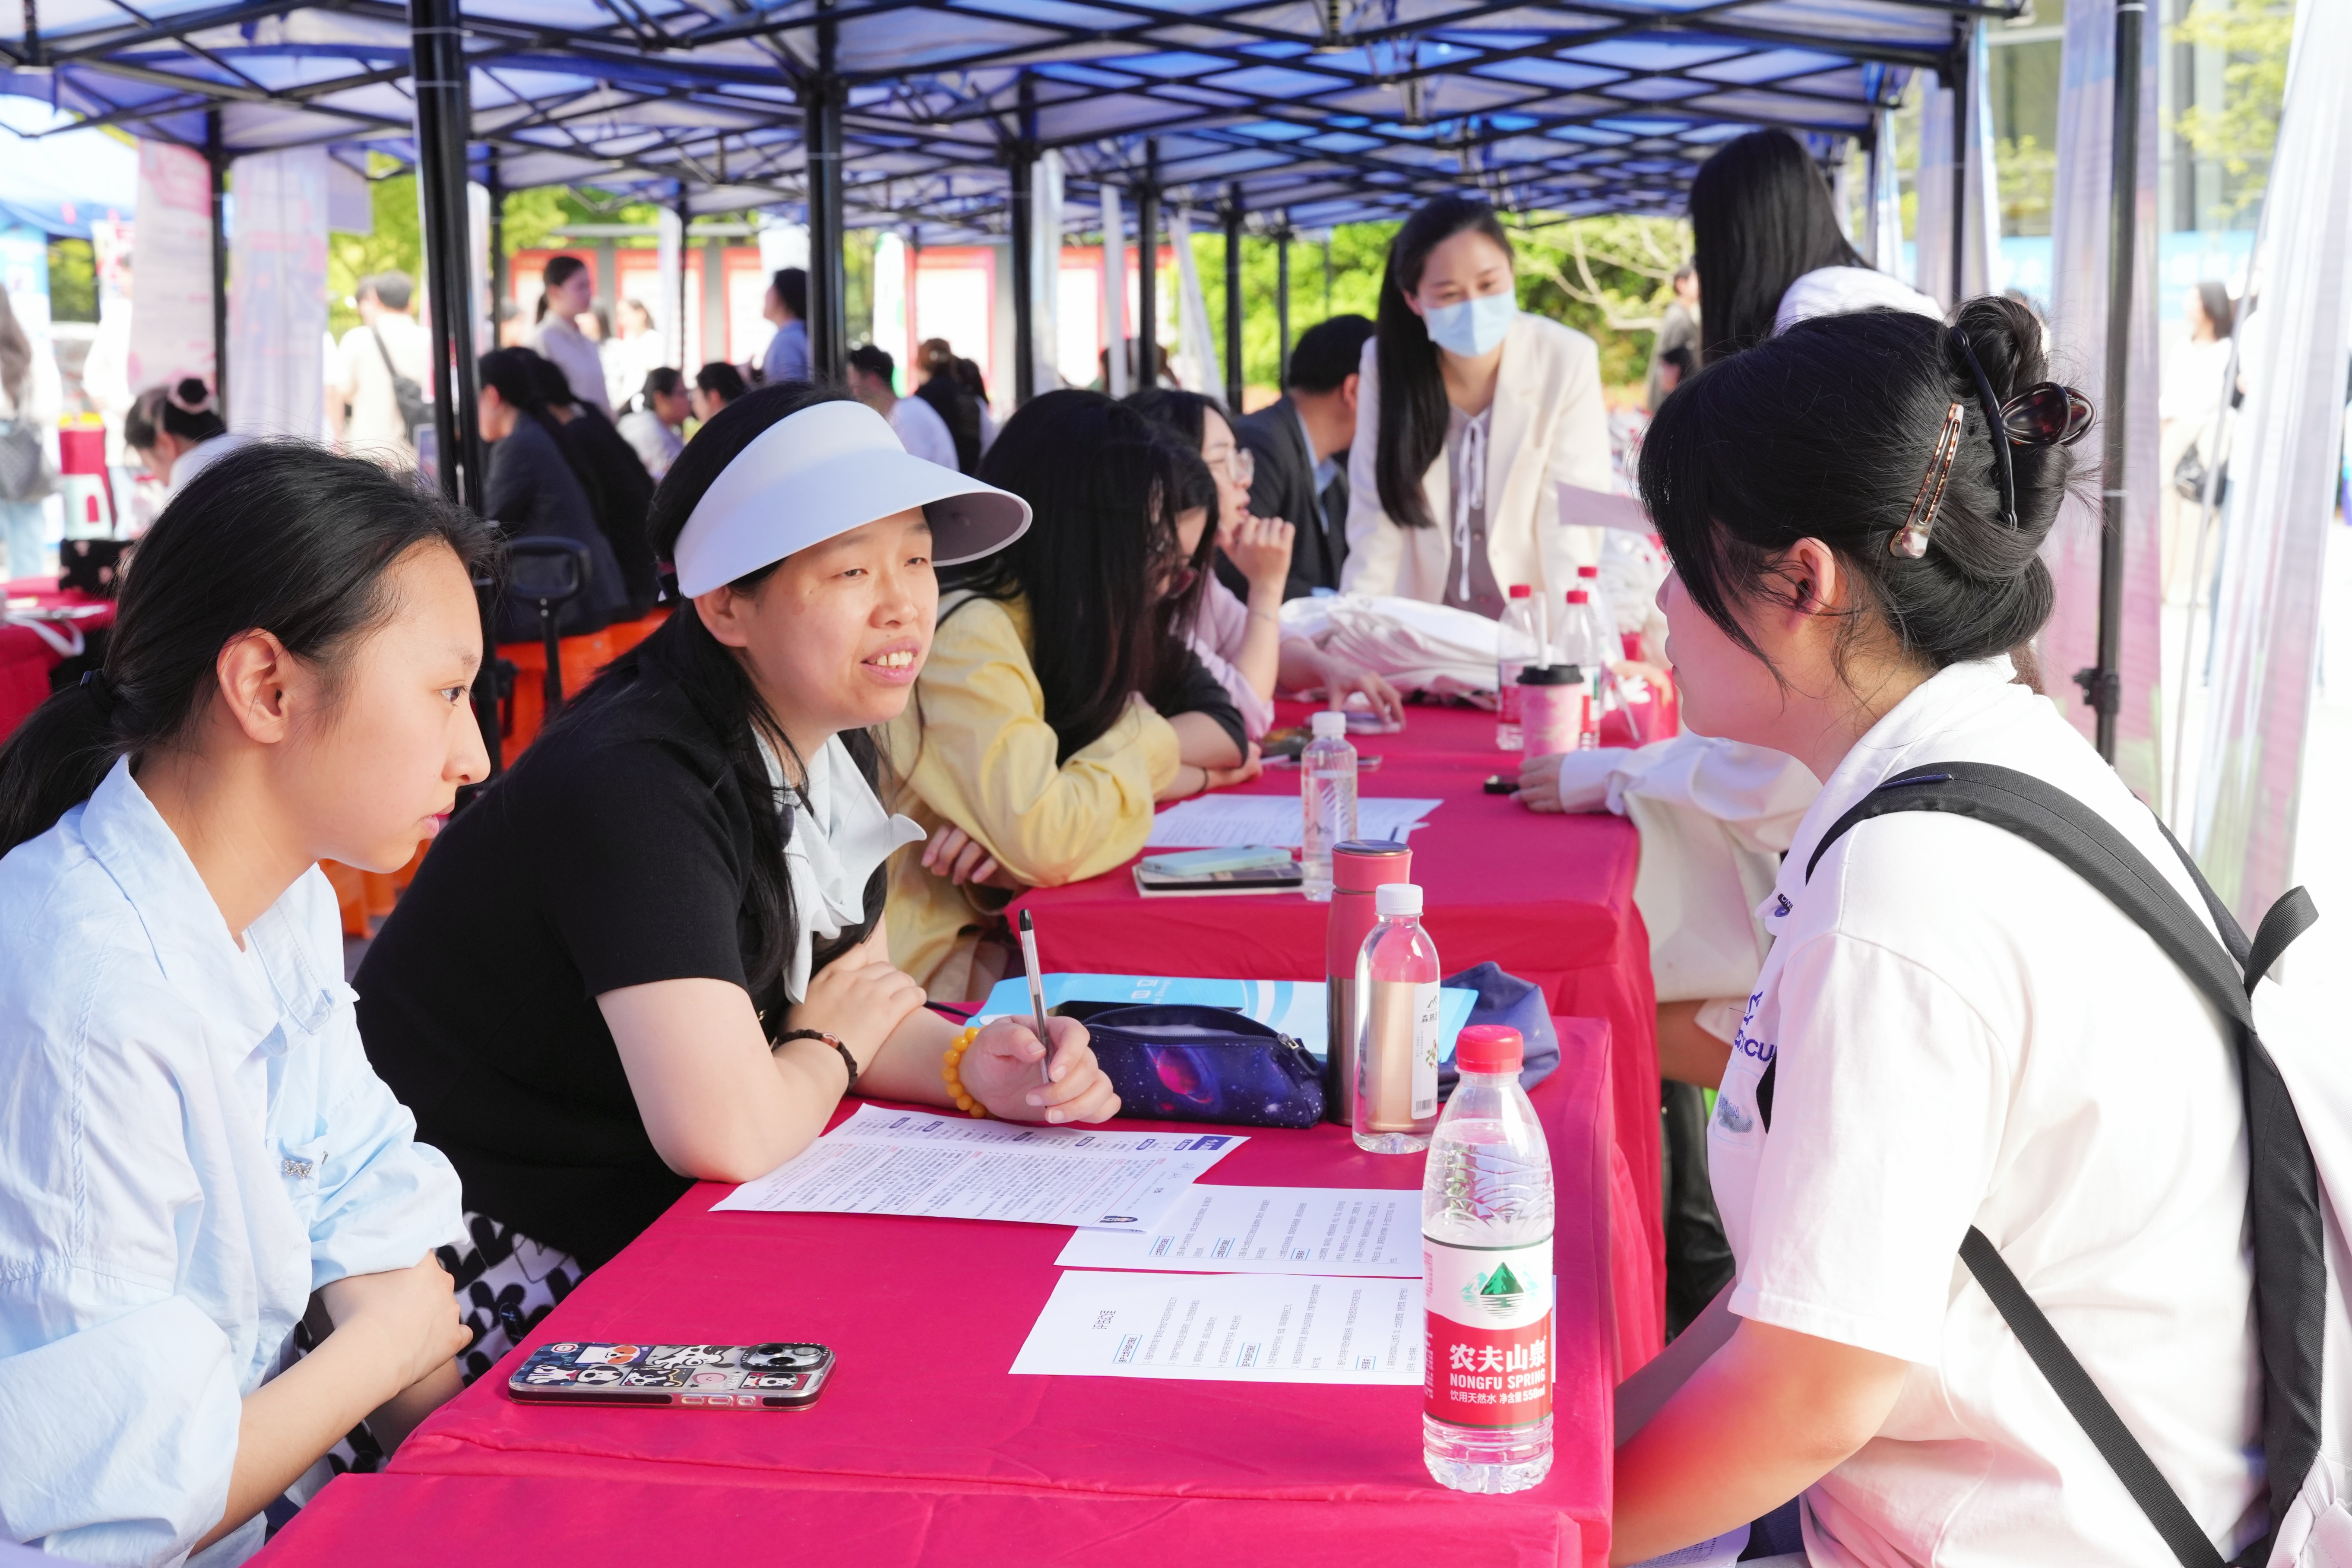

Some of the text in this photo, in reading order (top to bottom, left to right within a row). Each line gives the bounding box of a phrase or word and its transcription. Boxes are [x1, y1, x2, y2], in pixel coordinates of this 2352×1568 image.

[1092, 1310, 1116, 1329] 评估助理
[1450, 1340, 1546, 1373] 农夫山泉
[1450, 1368, 1545, 1390] NONGFU SPRING
[1450, 1390, 1497, 1404] 饮用天然水
